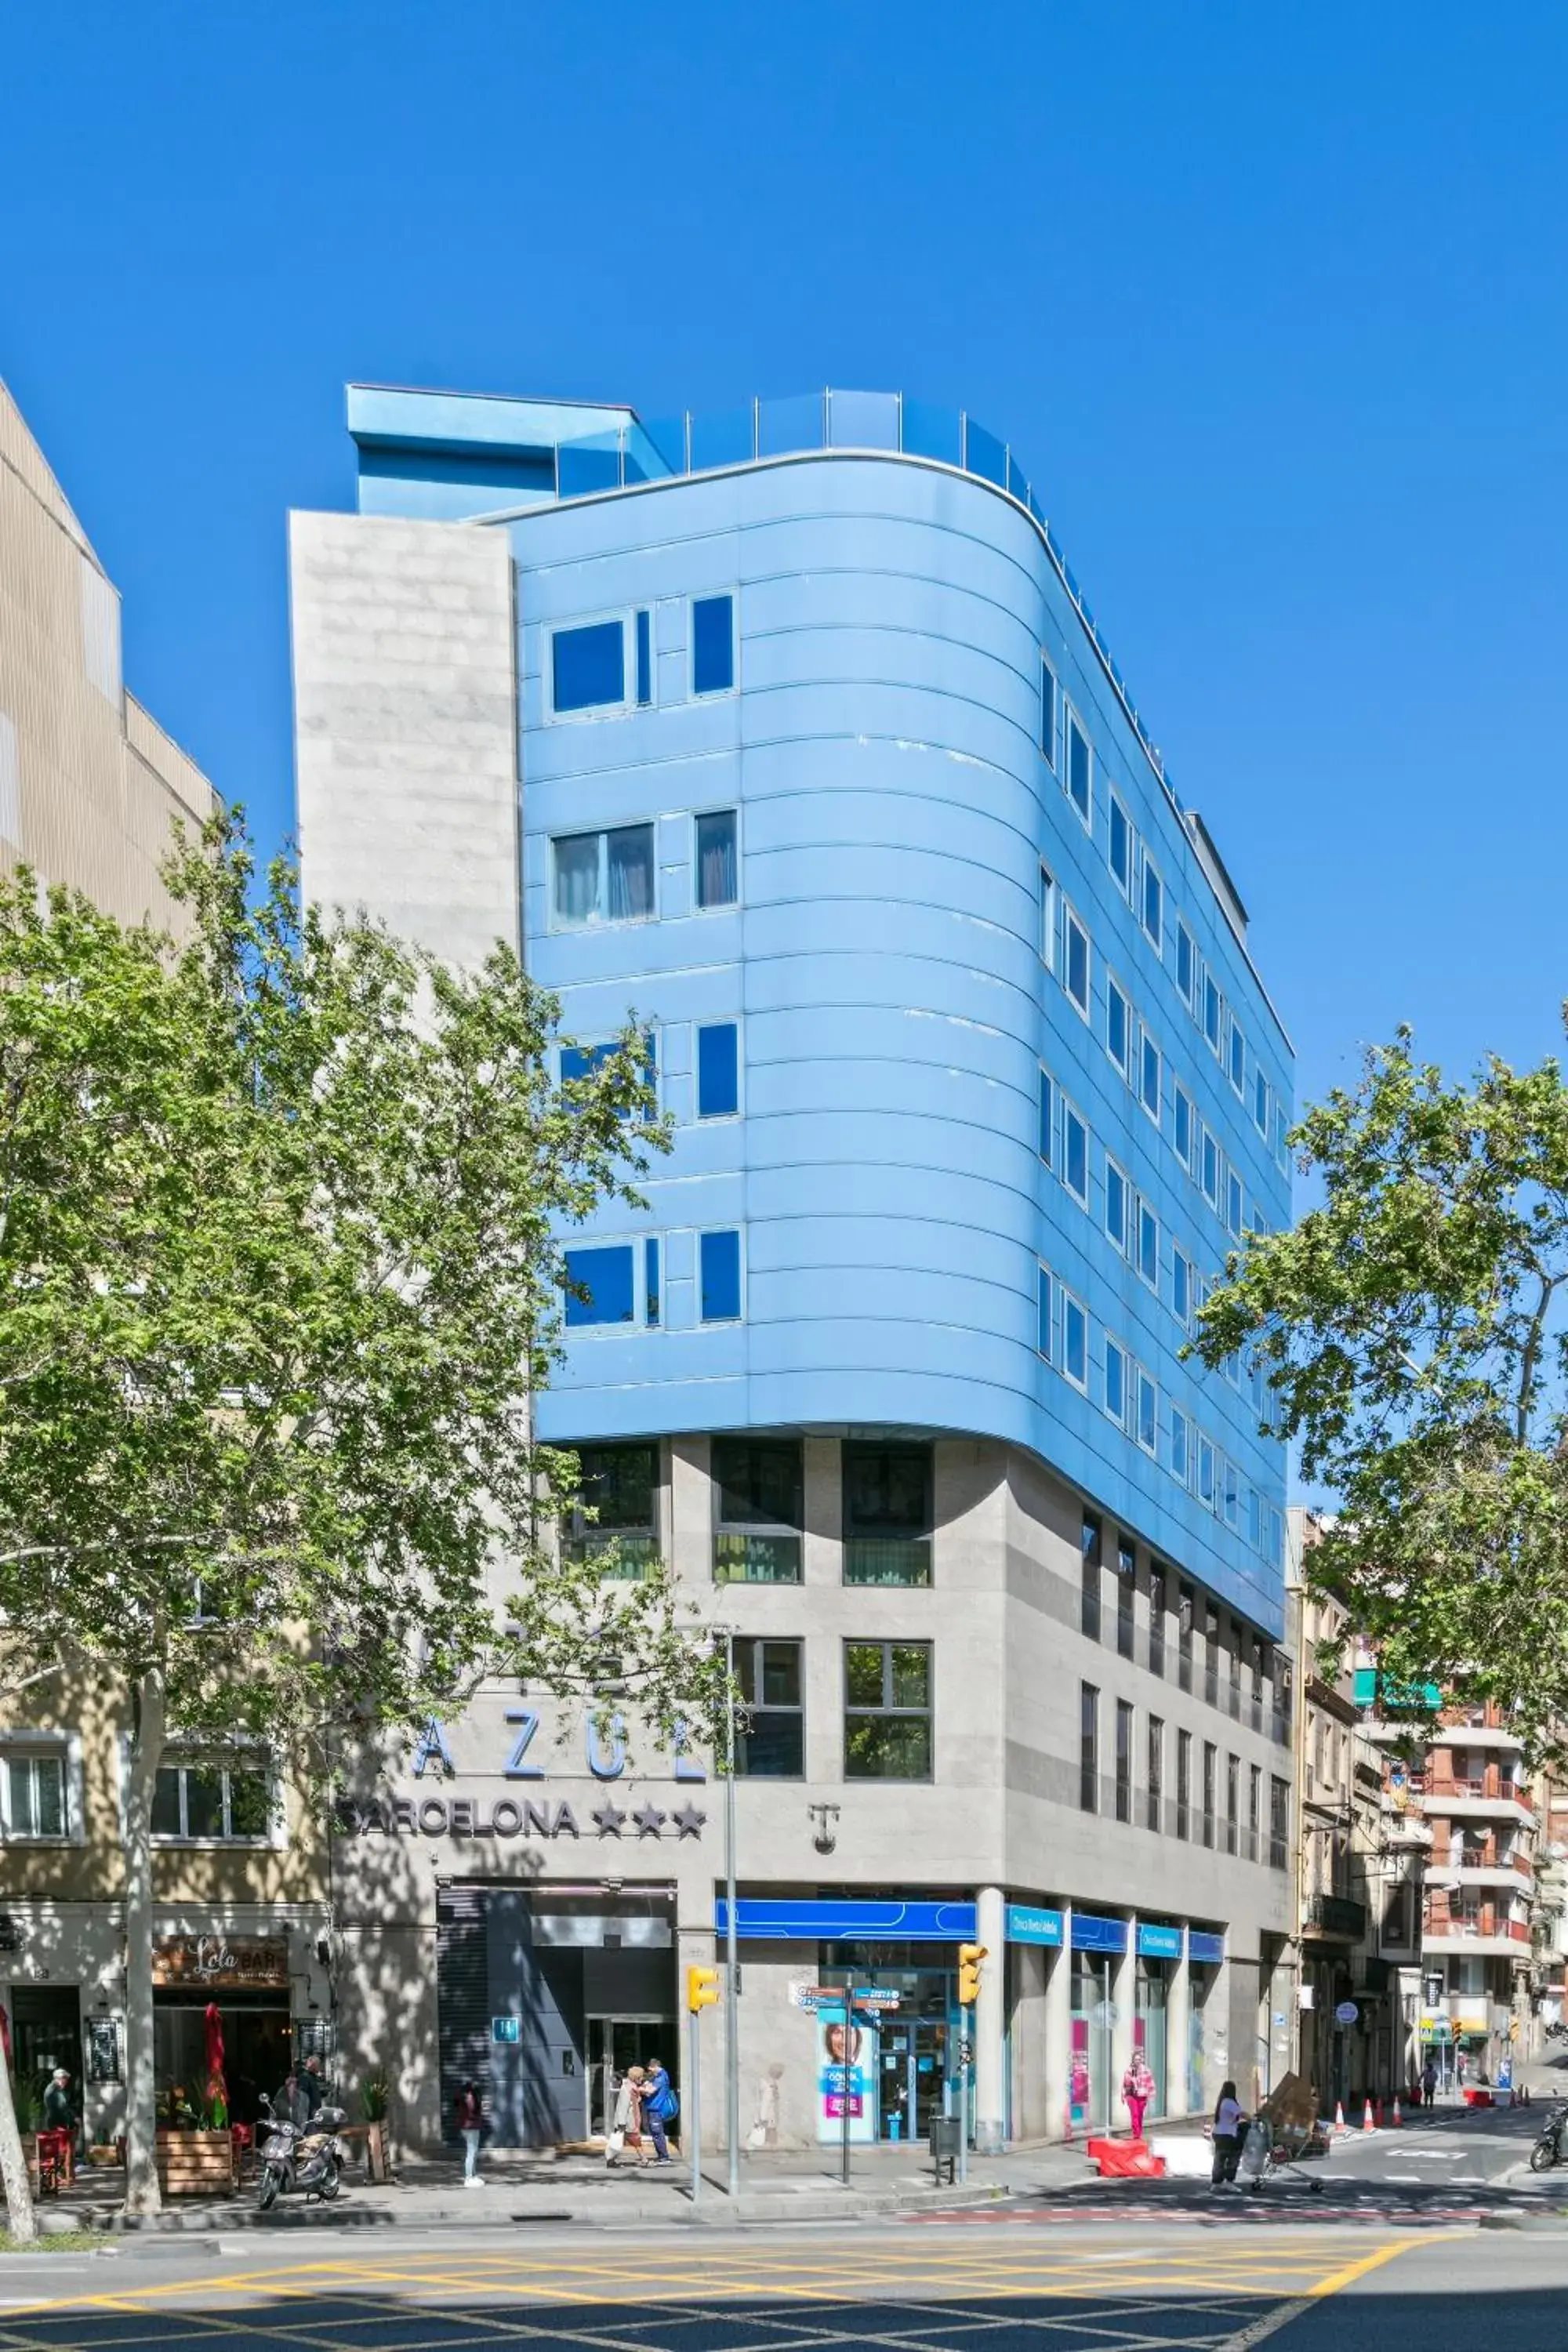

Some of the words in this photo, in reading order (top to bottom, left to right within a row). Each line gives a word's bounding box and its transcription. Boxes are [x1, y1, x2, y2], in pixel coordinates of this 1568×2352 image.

[412, 1708, 706, 1783] AZUL
[187, 1936, 238, 1973] Lola
[241, 1951, 274, 1969] BAR
